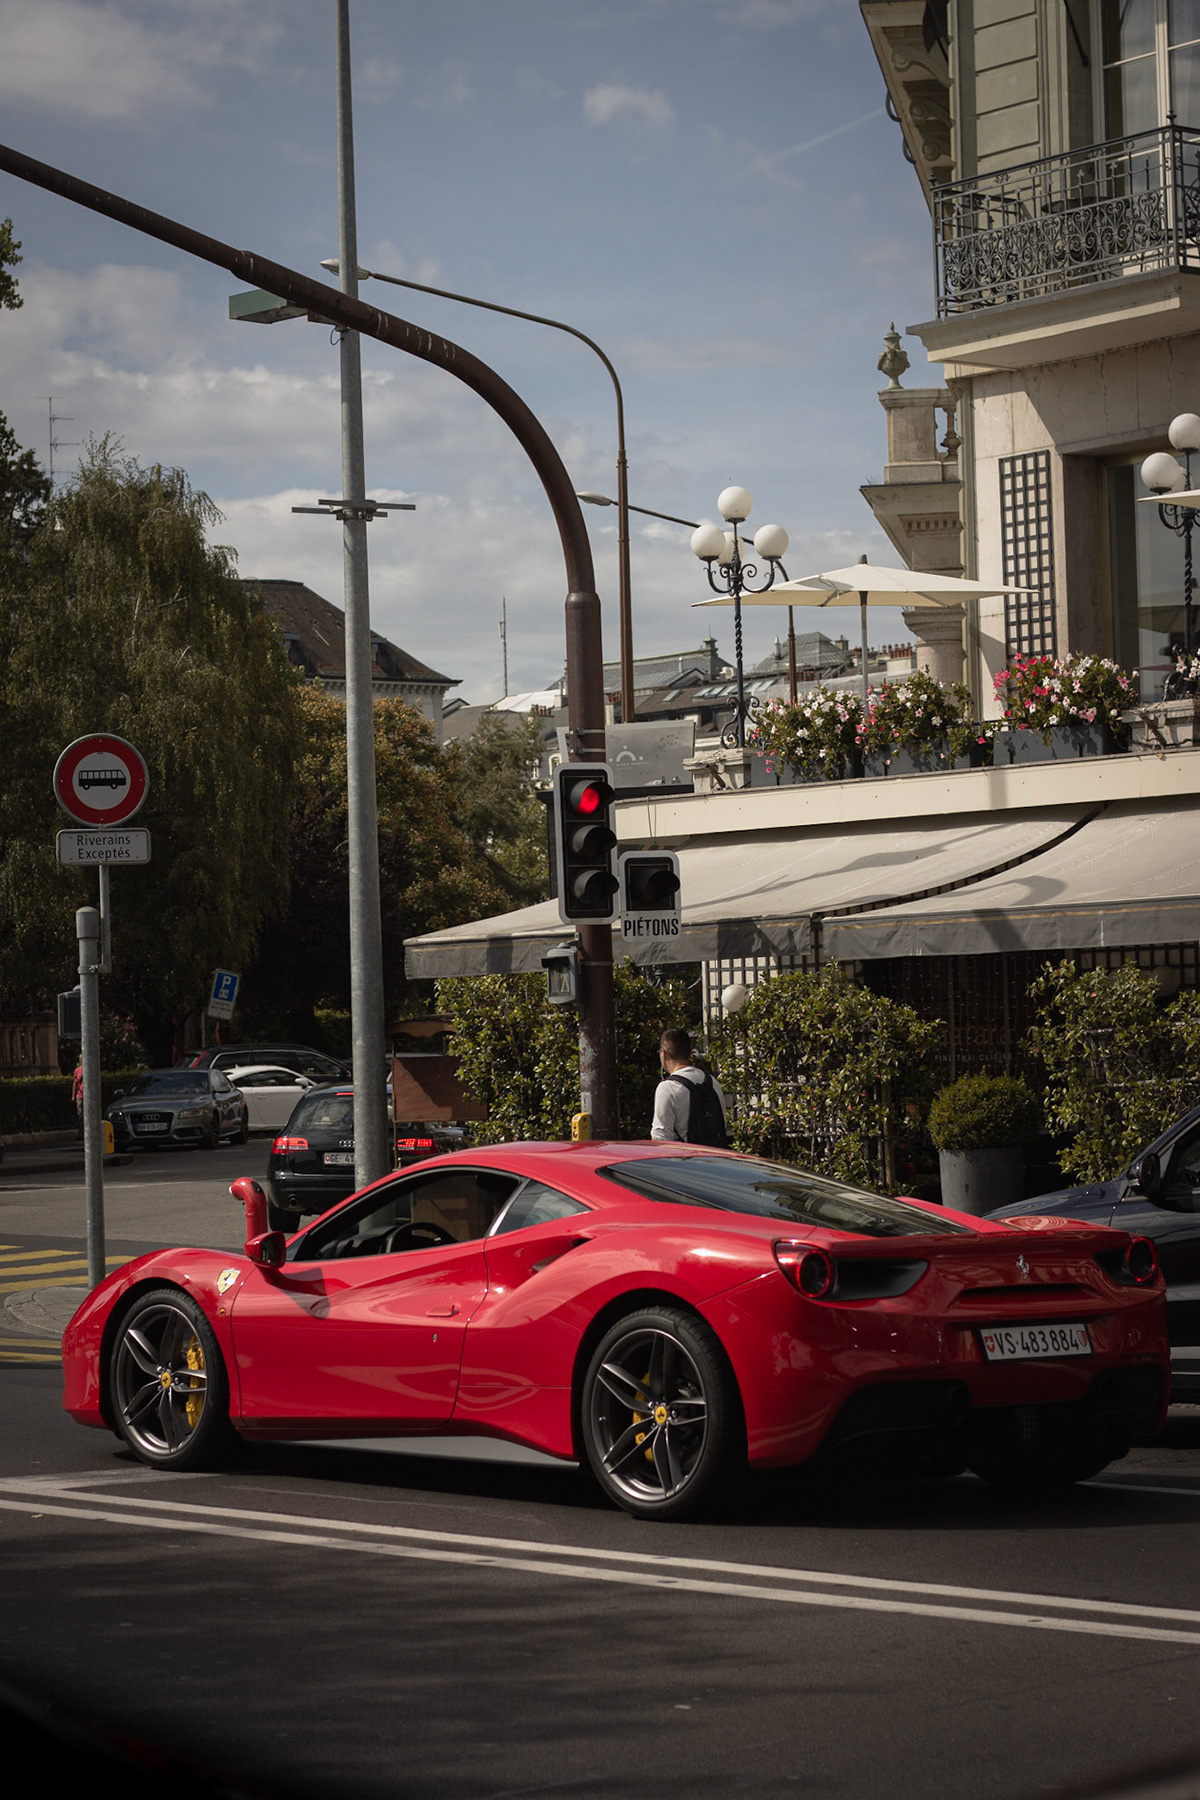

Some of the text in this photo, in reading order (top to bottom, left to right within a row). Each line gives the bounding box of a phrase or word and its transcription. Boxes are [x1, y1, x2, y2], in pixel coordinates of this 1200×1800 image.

[77, 834, 131, 845] Riverains
[78, 847, 131, 861] Exceptés
[624, 917, 678, 936] PIÉTONS
[221, 975, 232, 988] P
